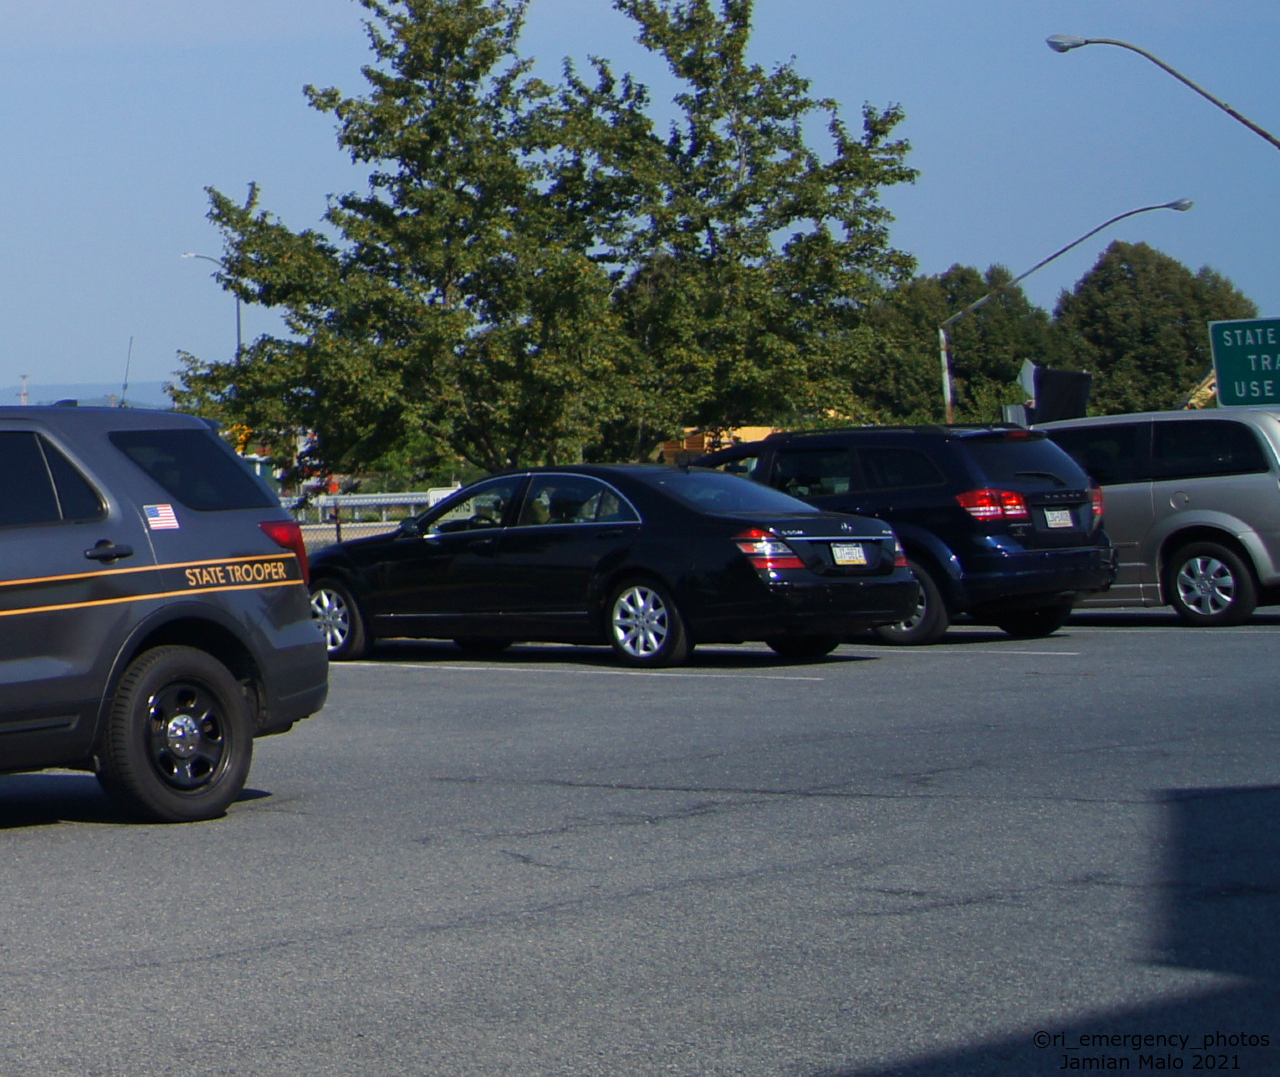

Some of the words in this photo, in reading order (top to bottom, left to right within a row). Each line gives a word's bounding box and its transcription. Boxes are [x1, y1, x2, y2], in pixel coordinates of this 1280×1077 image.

[1223, 328, 1277, 347] STATE
[1234, 380, 1275, 397] USE
[185, 566, 226, 586] STATE
[226, 562, 287, 583] TROOPER
